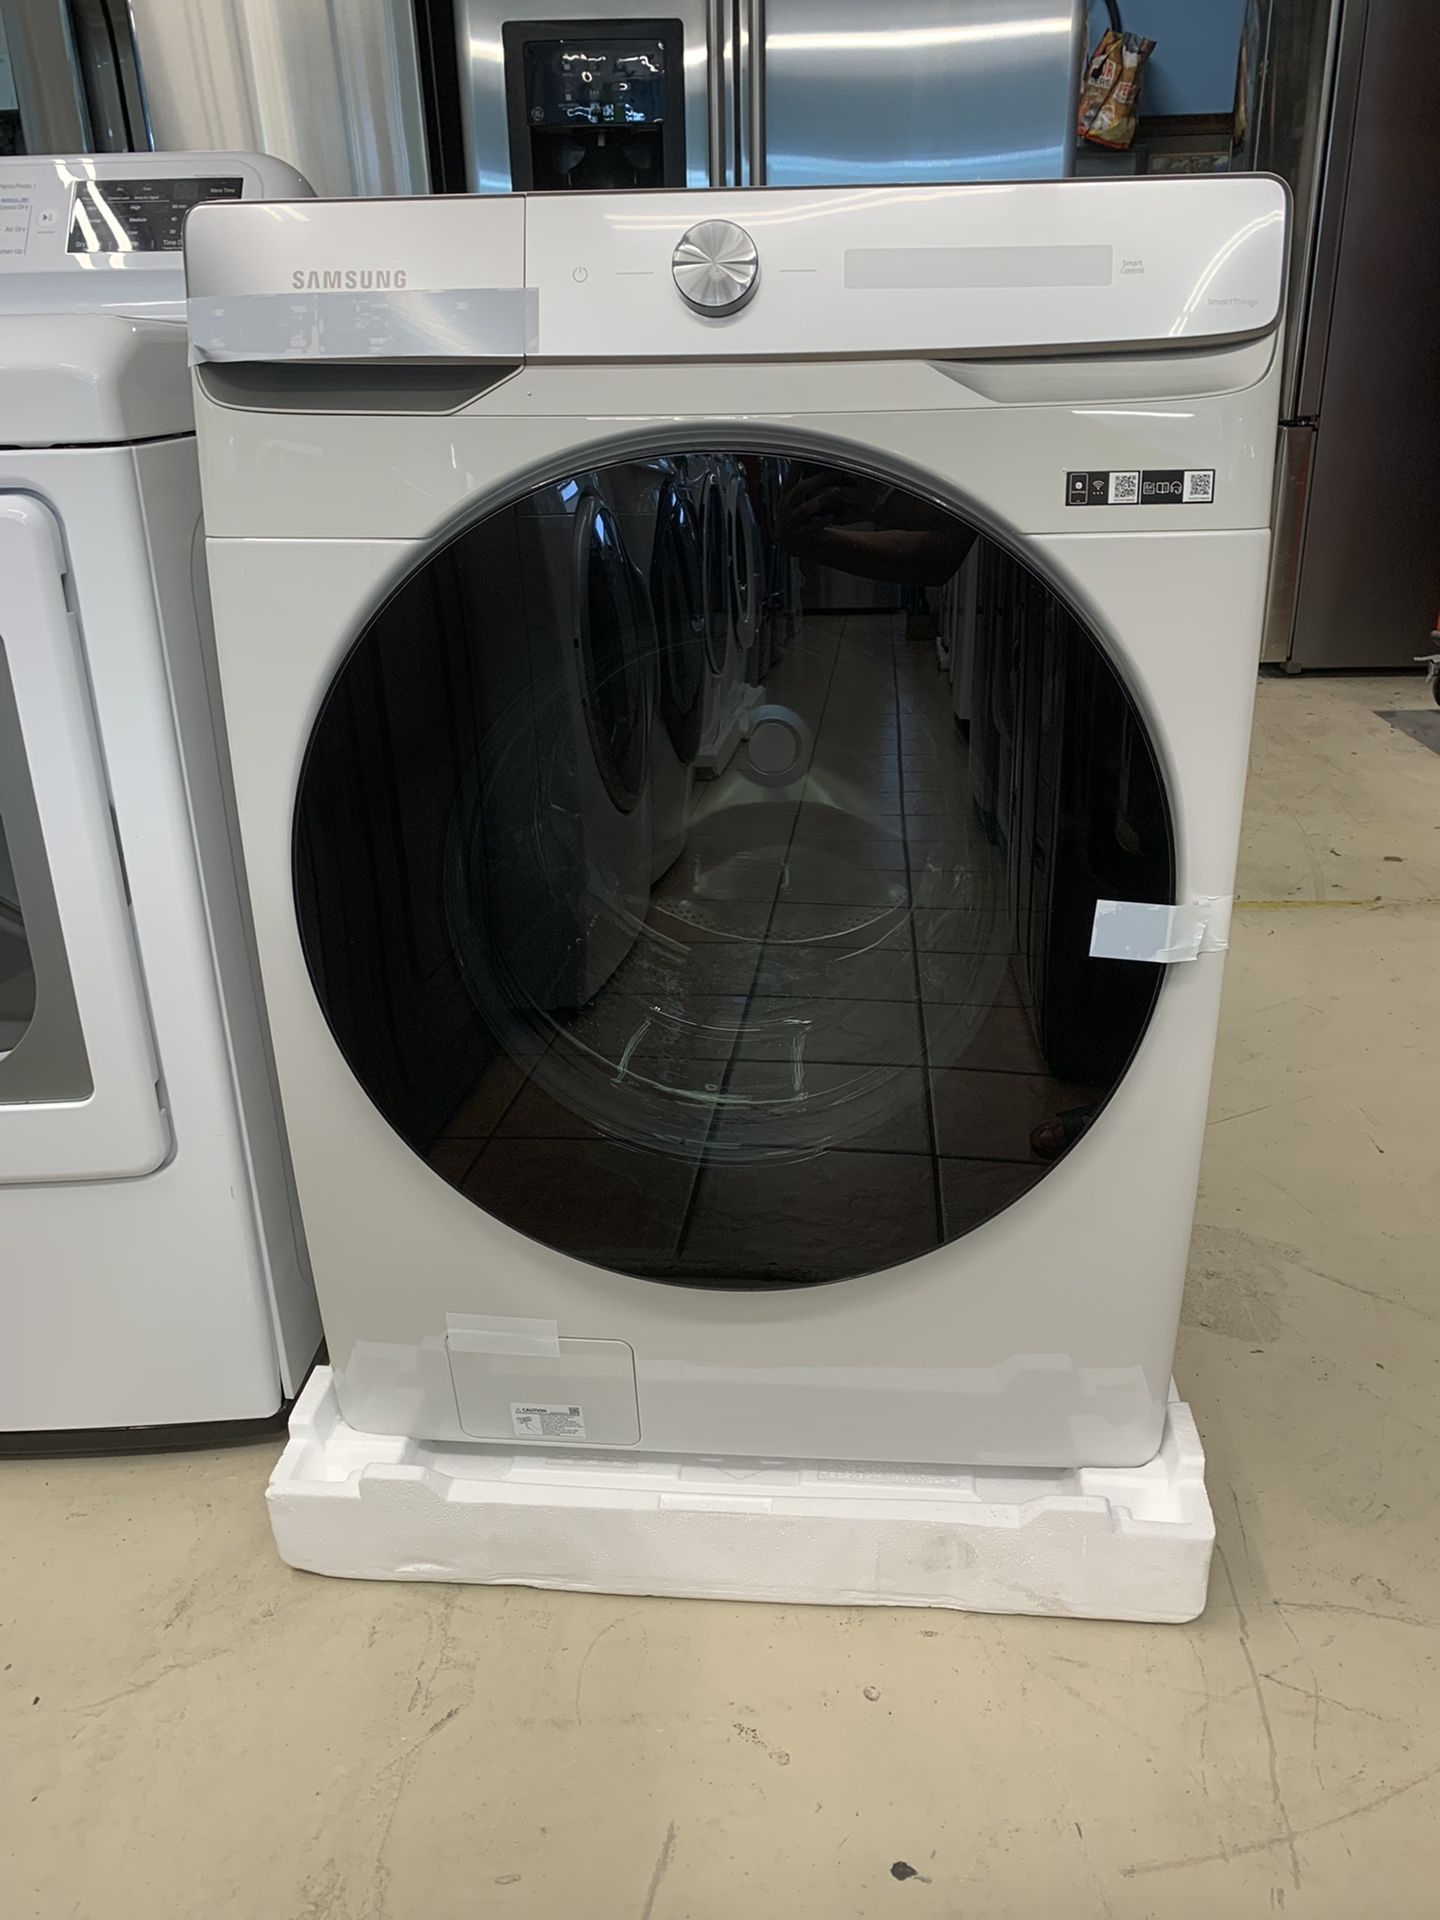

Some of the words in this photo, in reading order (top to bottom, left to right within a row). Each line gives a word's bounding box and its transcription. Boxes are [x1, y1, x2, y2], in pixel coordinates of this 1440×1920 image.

[1120, 266, 1144, 274] Control
[292, 270, 407, 289] SAMSUNG
[1207, 297, 1259, 307] SmartThings
